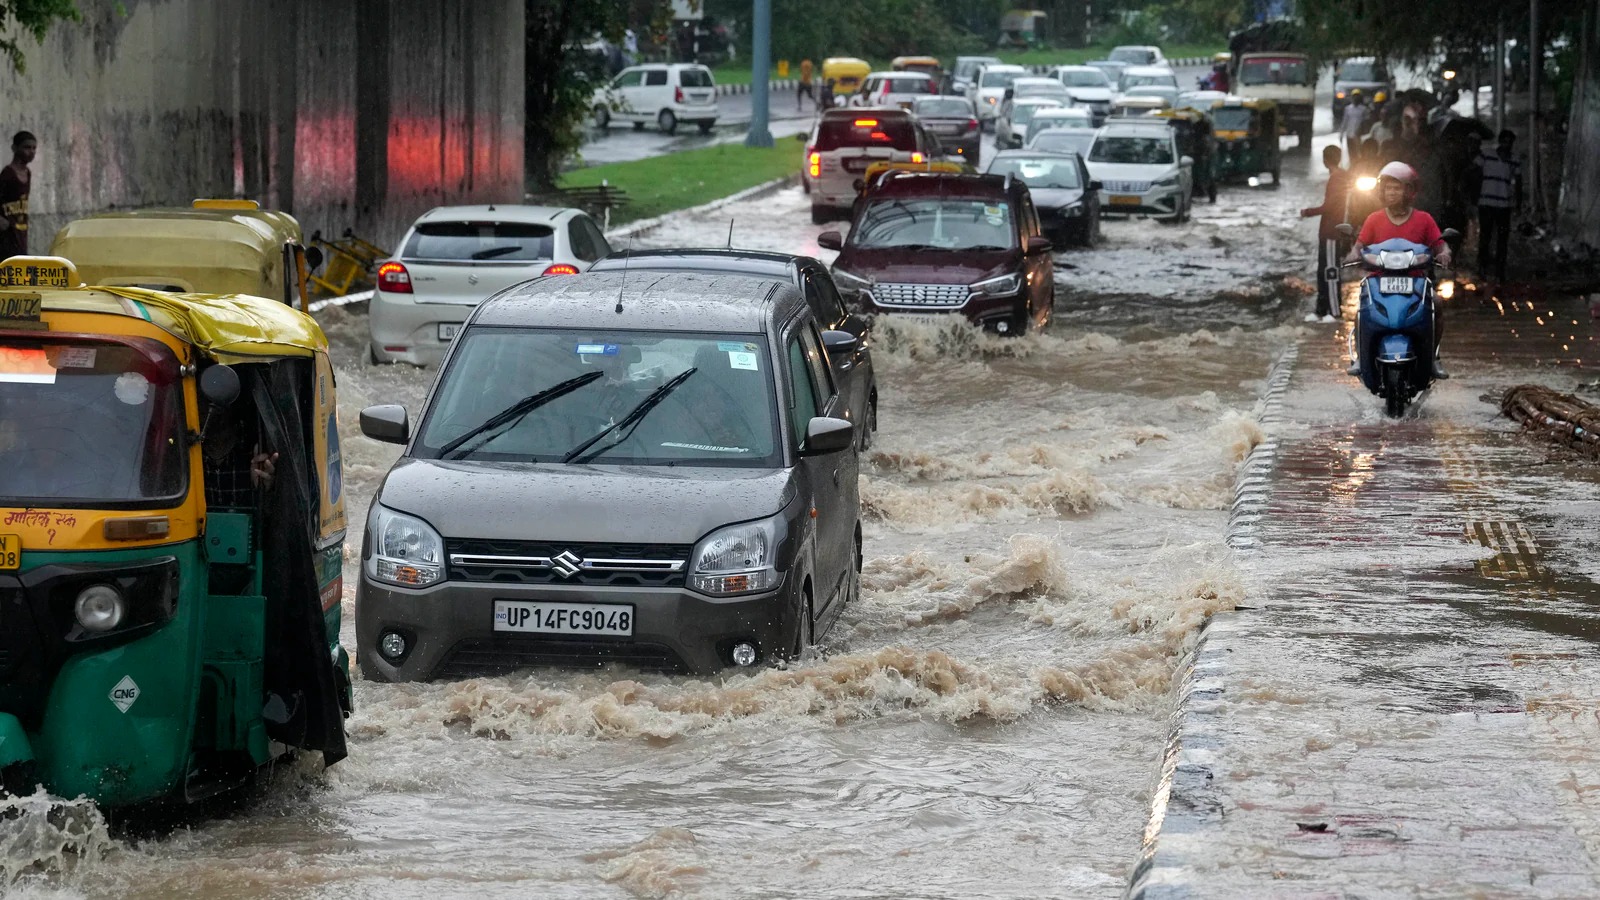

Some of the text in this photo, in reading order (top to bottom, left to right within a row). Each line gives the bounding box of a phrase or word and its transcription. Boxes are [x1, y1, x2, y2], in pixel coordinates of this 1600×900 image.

[0, 266, 68, 277] NCR PERMIT
[51, 278, 68, 287] UP
[507, 607, 630, 631] UP14FC9048
[114, 688, 135, 699] CNG
